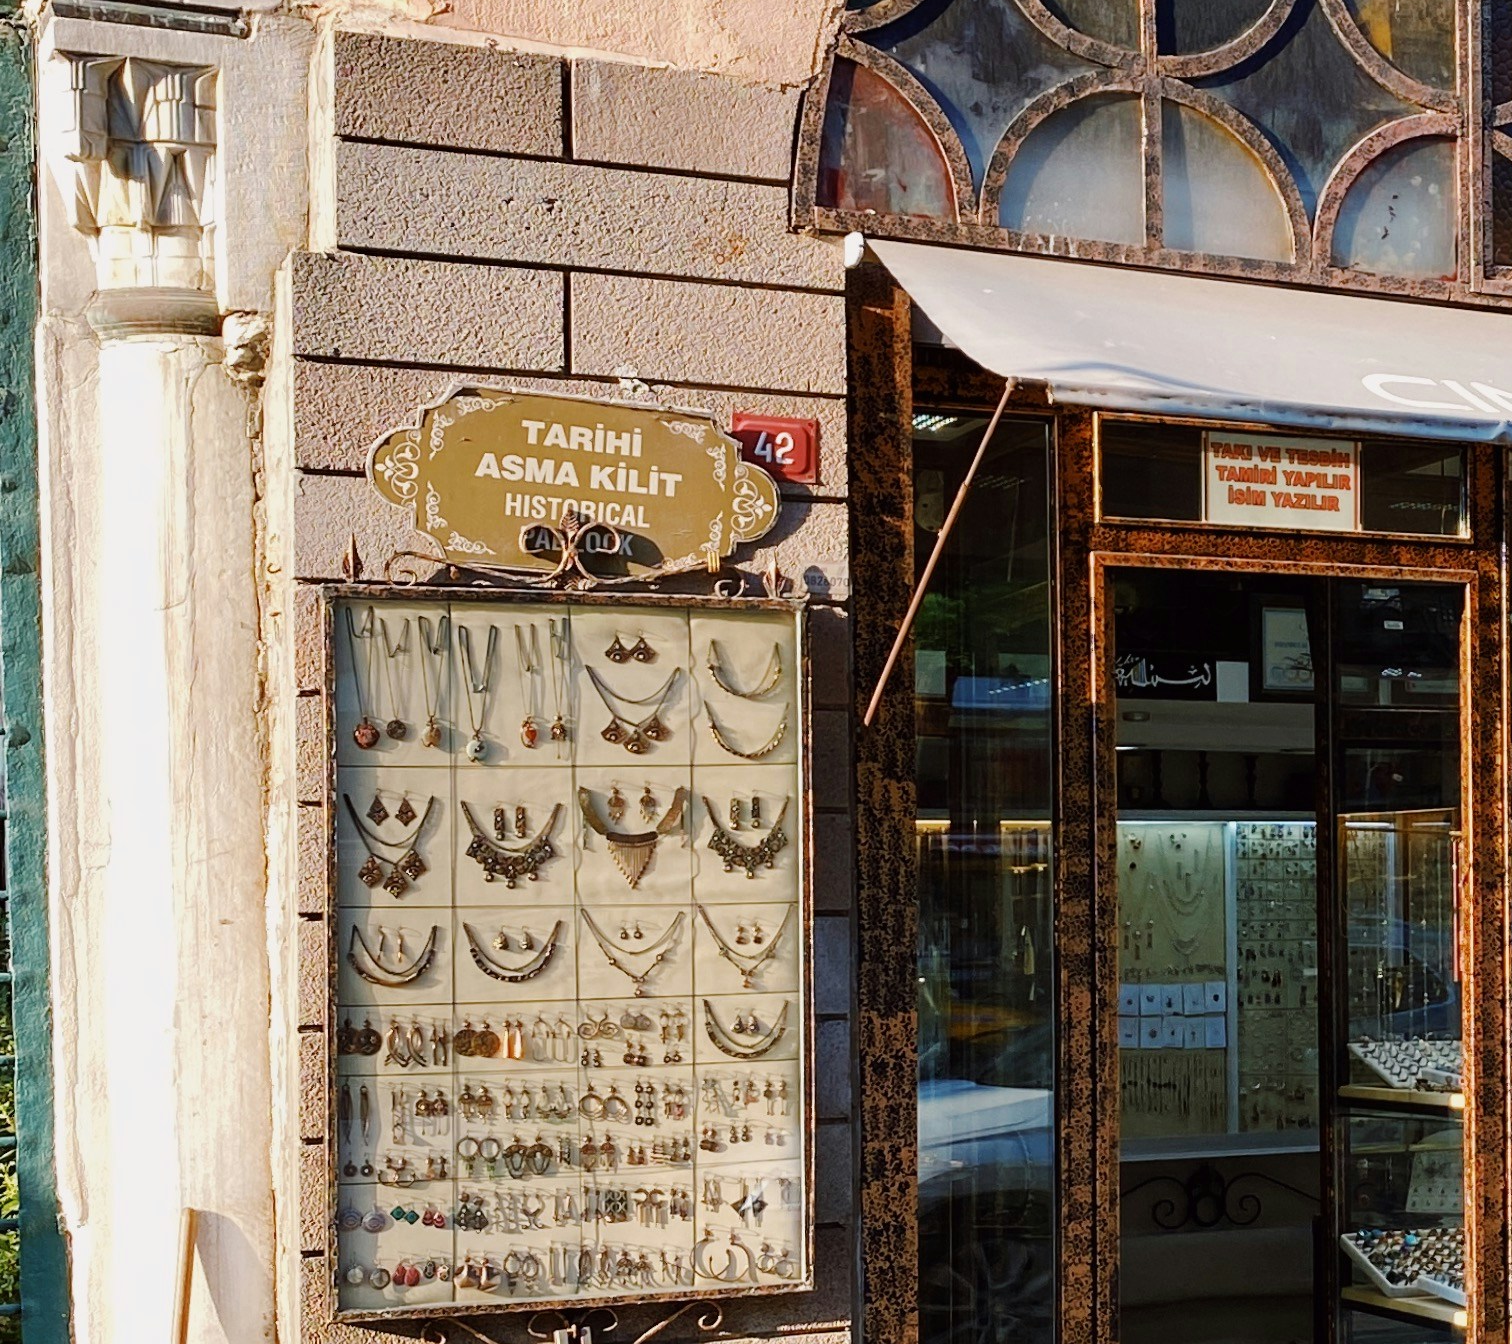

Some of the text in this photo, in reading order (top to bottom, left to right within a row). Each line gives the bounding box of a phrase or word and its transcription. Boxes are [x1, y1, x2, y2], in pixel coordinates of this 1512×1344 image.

[521, 419, 643, 457] TARİHİ
[754, 431, 795, 465] 42
[1210, 442, 1253, 461] TAKI
[1257, 446, 1281, 463] VE
[474, 452, 683, 498] ASMA KİLİT
[1215, 464, 1351, 490] TAMİRİ YAPILIR
[505, 492, 650, 528] HISTORICAL
[1228, 485, 1340, 512] İSİM YAZILIR
